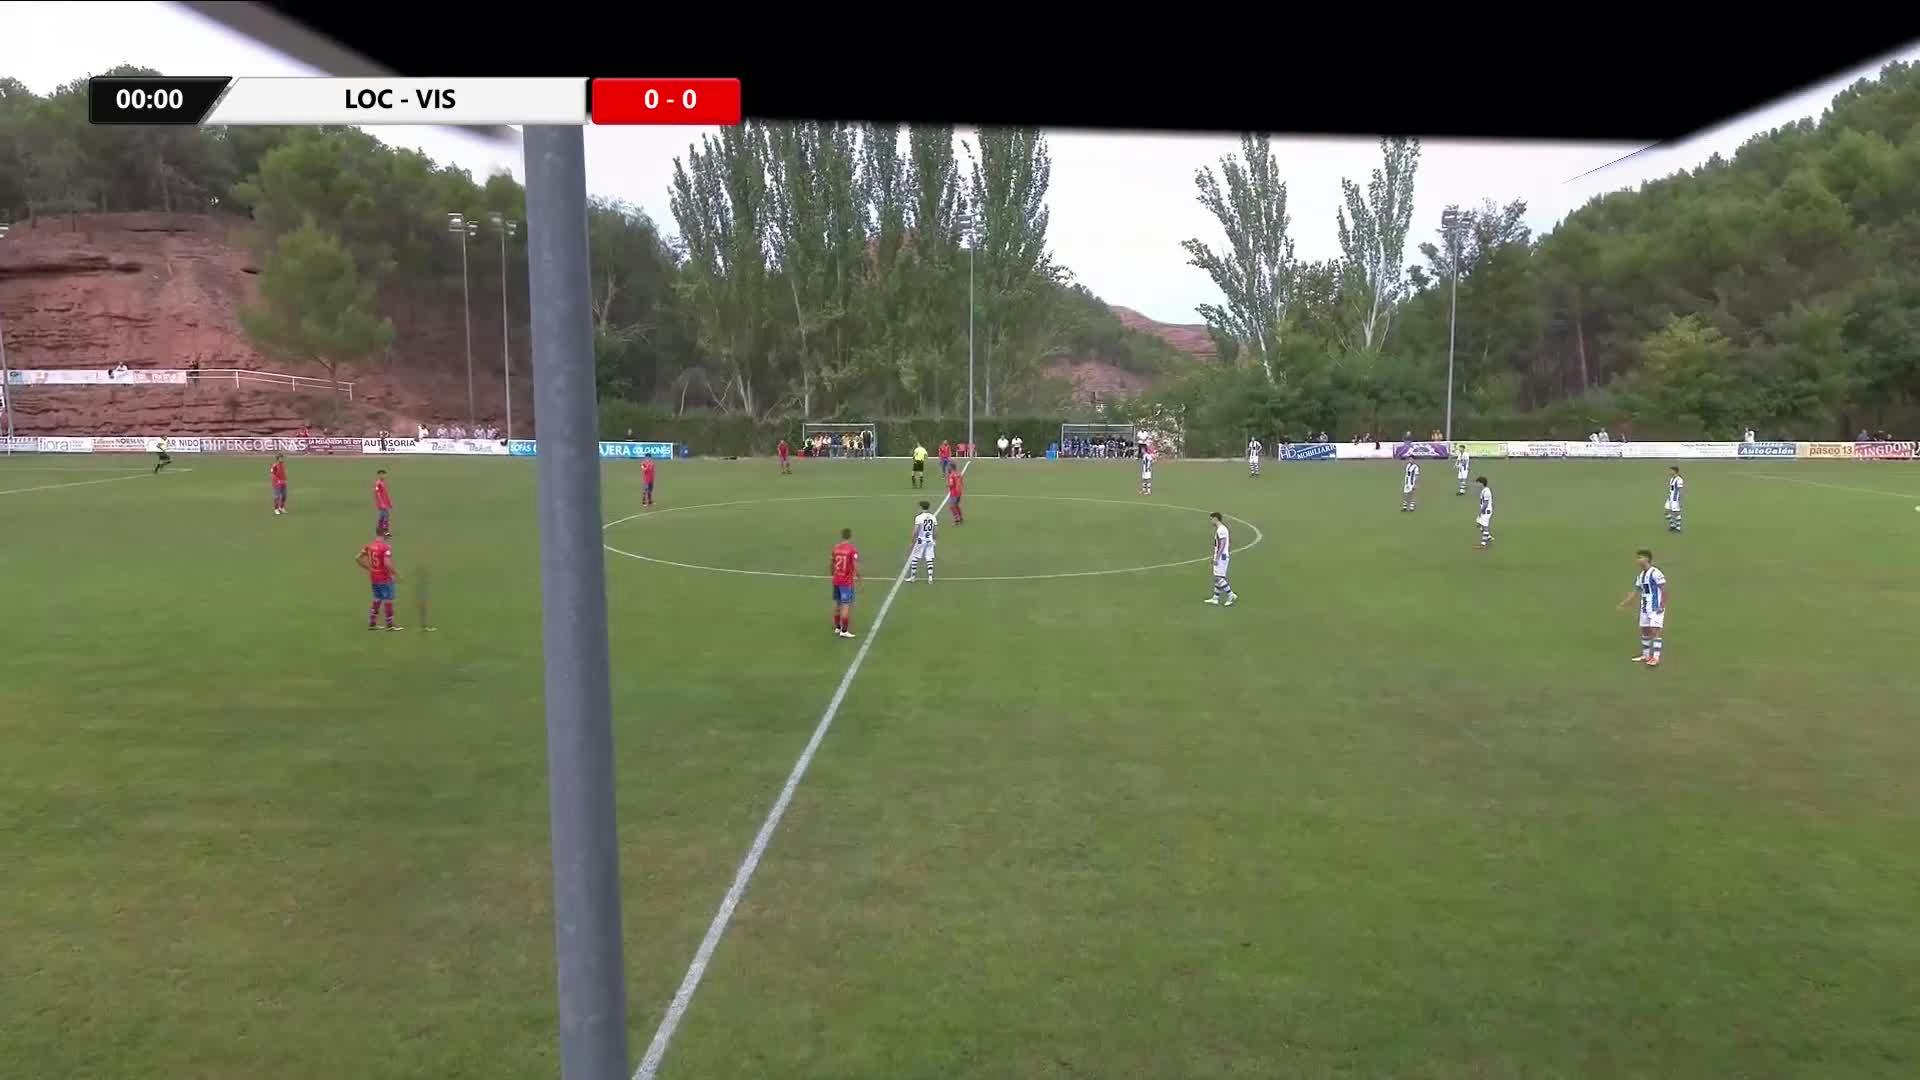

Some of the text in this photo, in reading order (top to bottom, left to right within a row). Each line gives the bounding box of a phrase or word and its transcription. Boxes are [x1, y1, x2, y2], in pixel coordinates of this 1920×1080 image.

[179, 439, 200, 447] NIDO
[364, 439, 416, 447] AUTOSORIA
[632, 445, 671, 456] COLCHONES
[1741, 446, 1795, 455] AutoGalán
[1809, 446, 1841, 457] paseo
[923, 518, 933, 532] 23
[835, 555, 847, 570] 21
